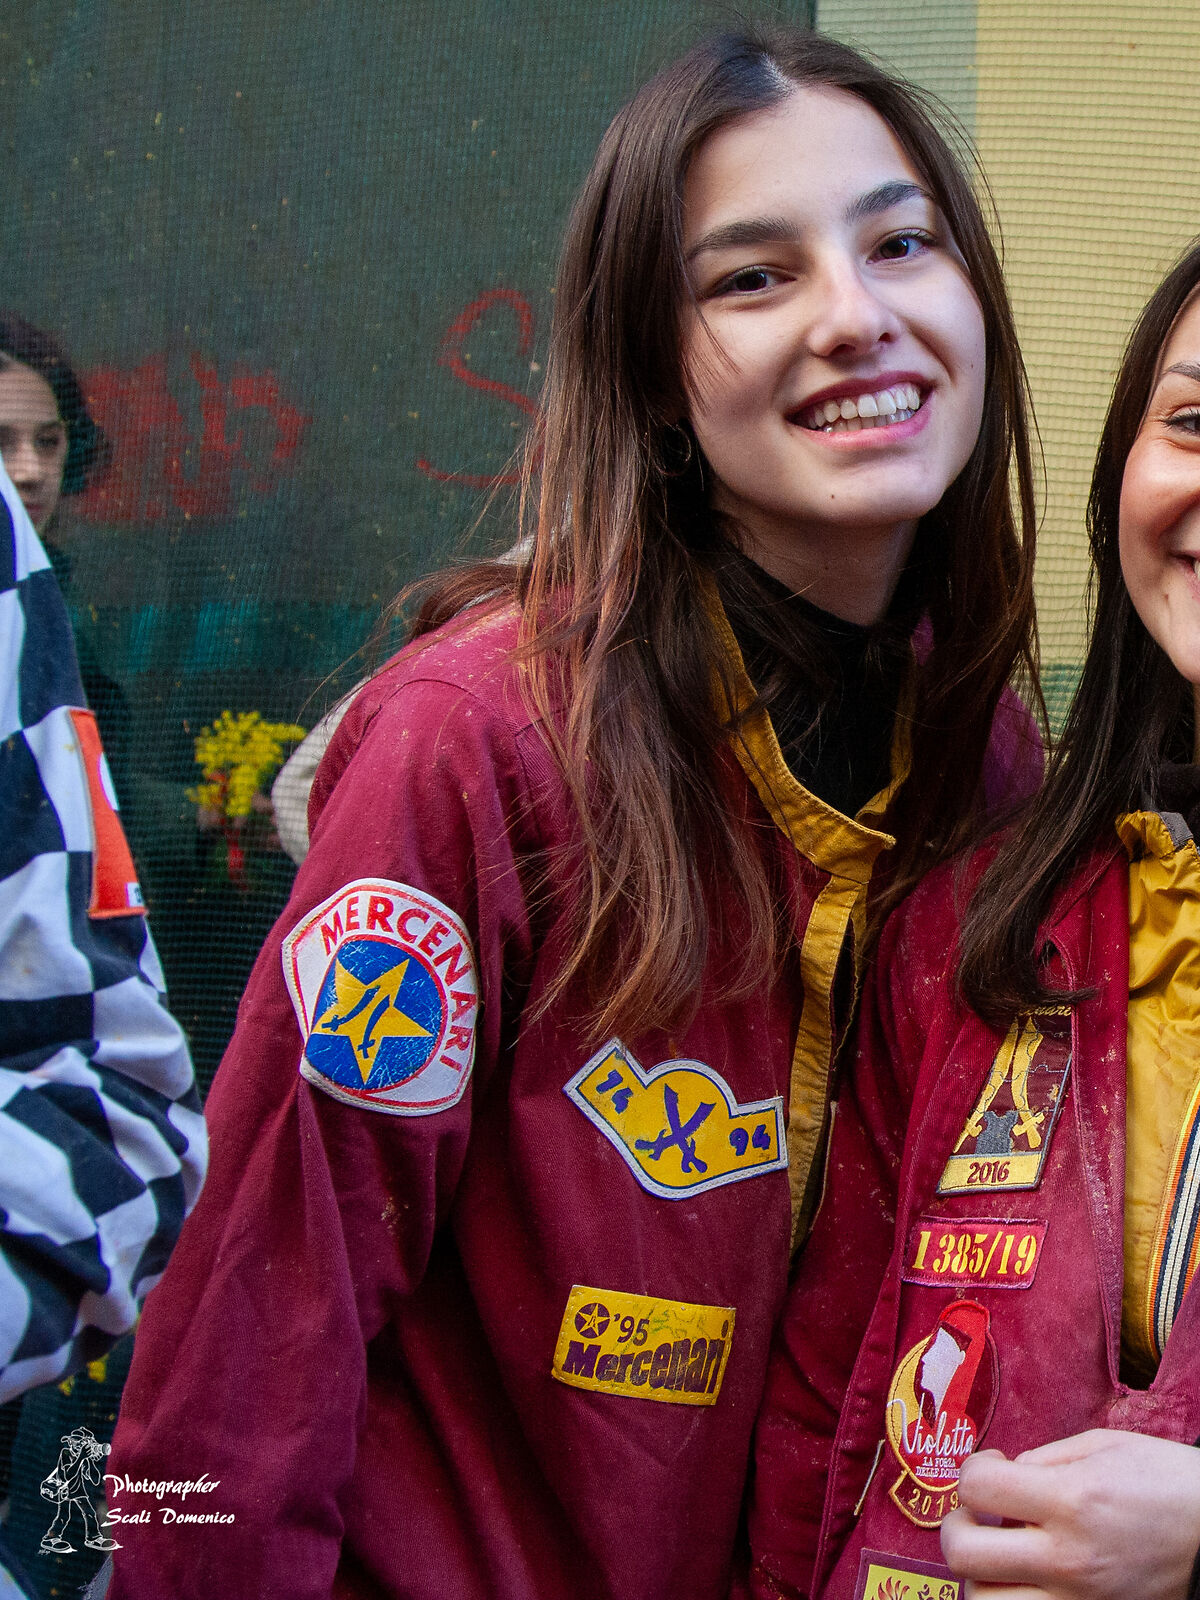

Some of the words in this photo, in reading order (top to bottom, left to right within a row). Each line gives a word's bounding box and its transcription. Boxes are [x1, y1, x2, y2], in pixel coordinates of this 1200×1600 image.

[319, 894, 478, 1074] MERCENARI
[728, 1123, 772, 1157] 94
[966, 1160, 1011, 1184] 2016
[613, 1312, 650, 1347] '95
[561, 1319, 729, 1394] Mercenari
[886, 1391, 975, 1458] Violetta
[915, 1466, 939, 1478] DELLE
[922, 1456, 933, 1467] LA
[907, 1488, 959, 1518] 2019
